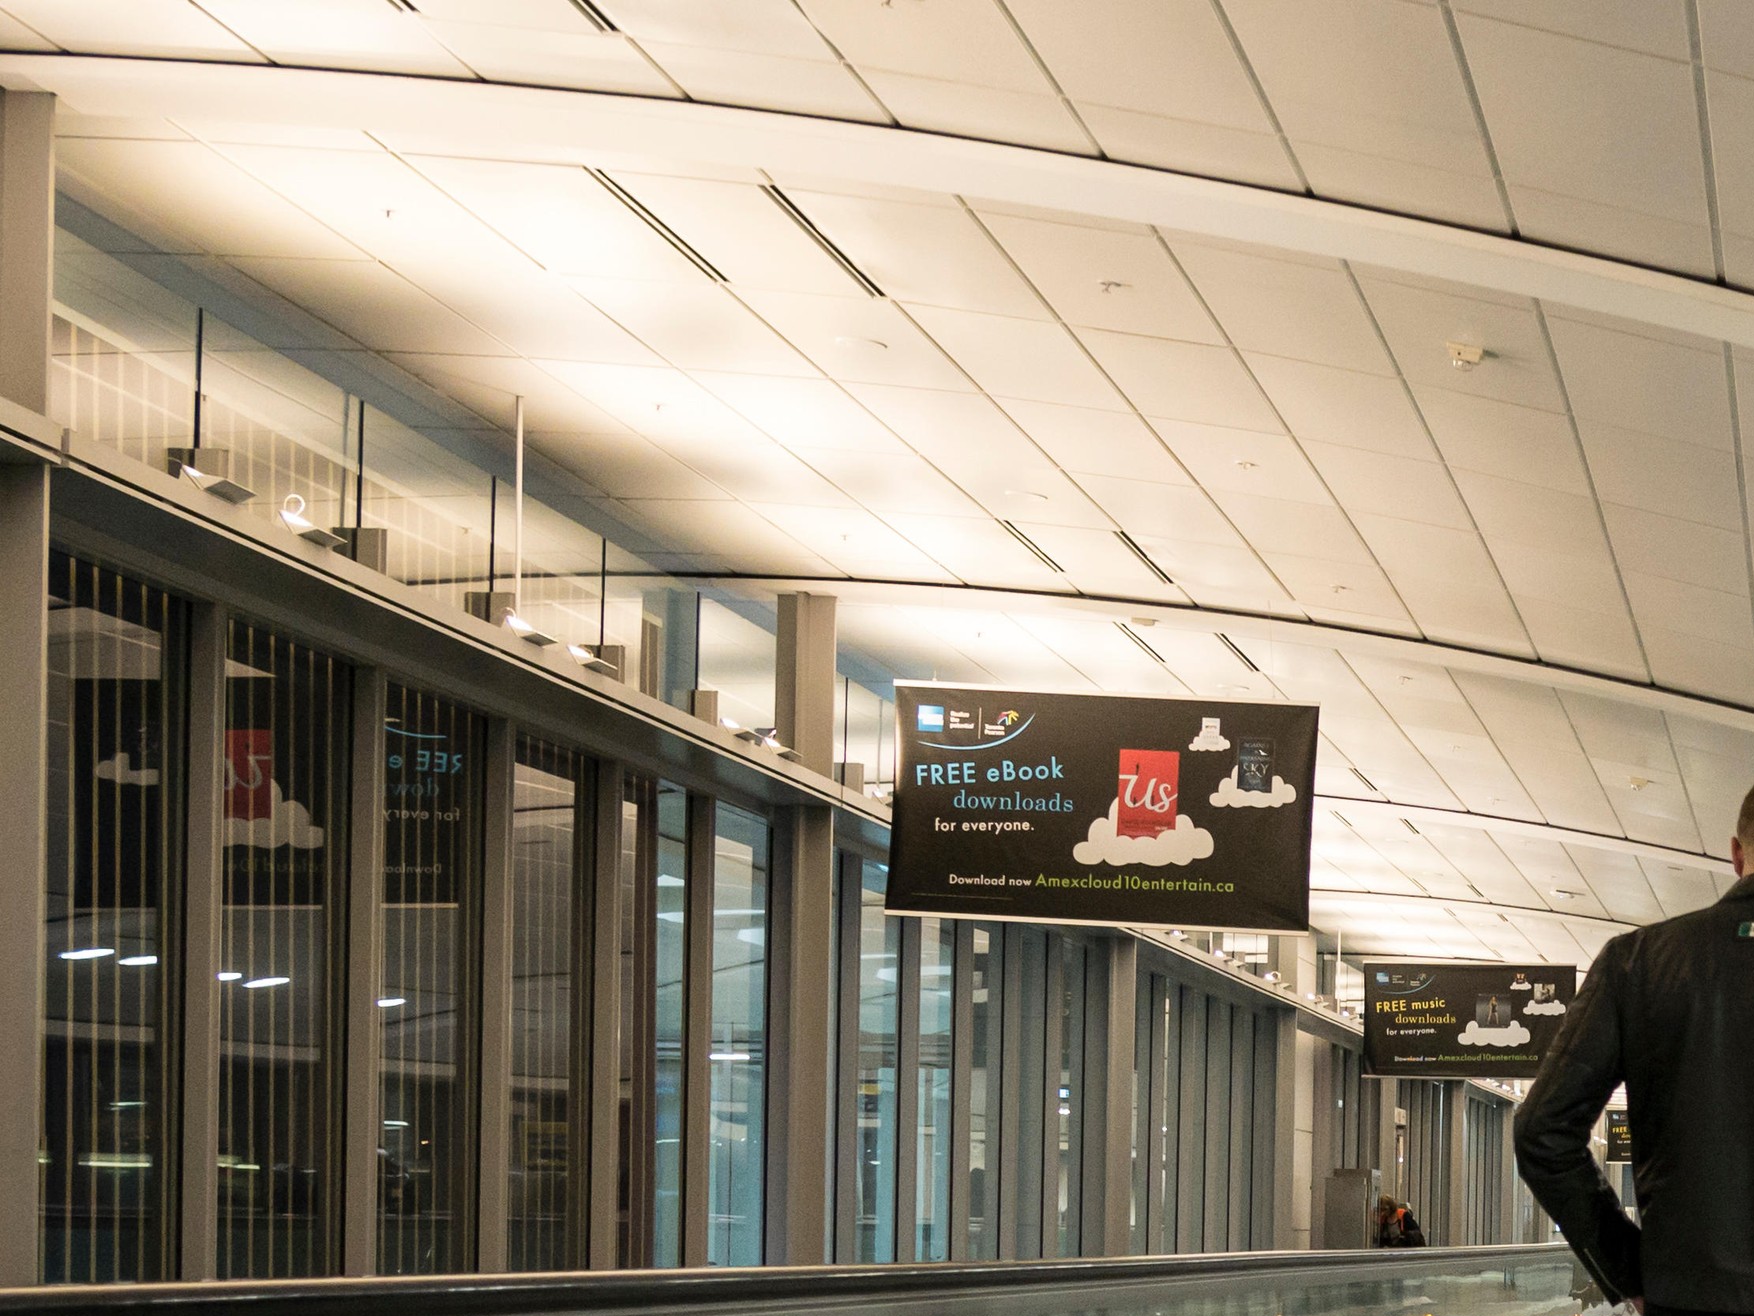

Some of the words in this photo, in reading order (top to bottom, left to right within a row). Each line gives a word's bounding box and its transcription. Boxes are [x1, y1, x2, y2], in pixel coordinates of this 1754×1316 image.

[915, 762, 977, 786] FREE
[986, 756, 1065, 783] eBook
[953, 789, 1074, 813] downloads
[1118, 774, 1179, 813] Us
[934, 817, 957, 832] for
[961, 817, 1035, 836] everyone.
[948, 873, 1006, 887] Download
[1008, 876, 1032, 887] now
[1035, 873, 1235, 894] Amexcloud10entertain.ca
[1375, 999, 1407, 1013] FREE
[1411, 997, 1446, 1011] music
[1395, 1013, 1457, 1025] downloads
[1386, 1027, 1397, 1036] for
[1400, 1027, 1437, 1036] everyone.
[1437, 1053, 1539, 1063] Amexcloud10entertain.ca
